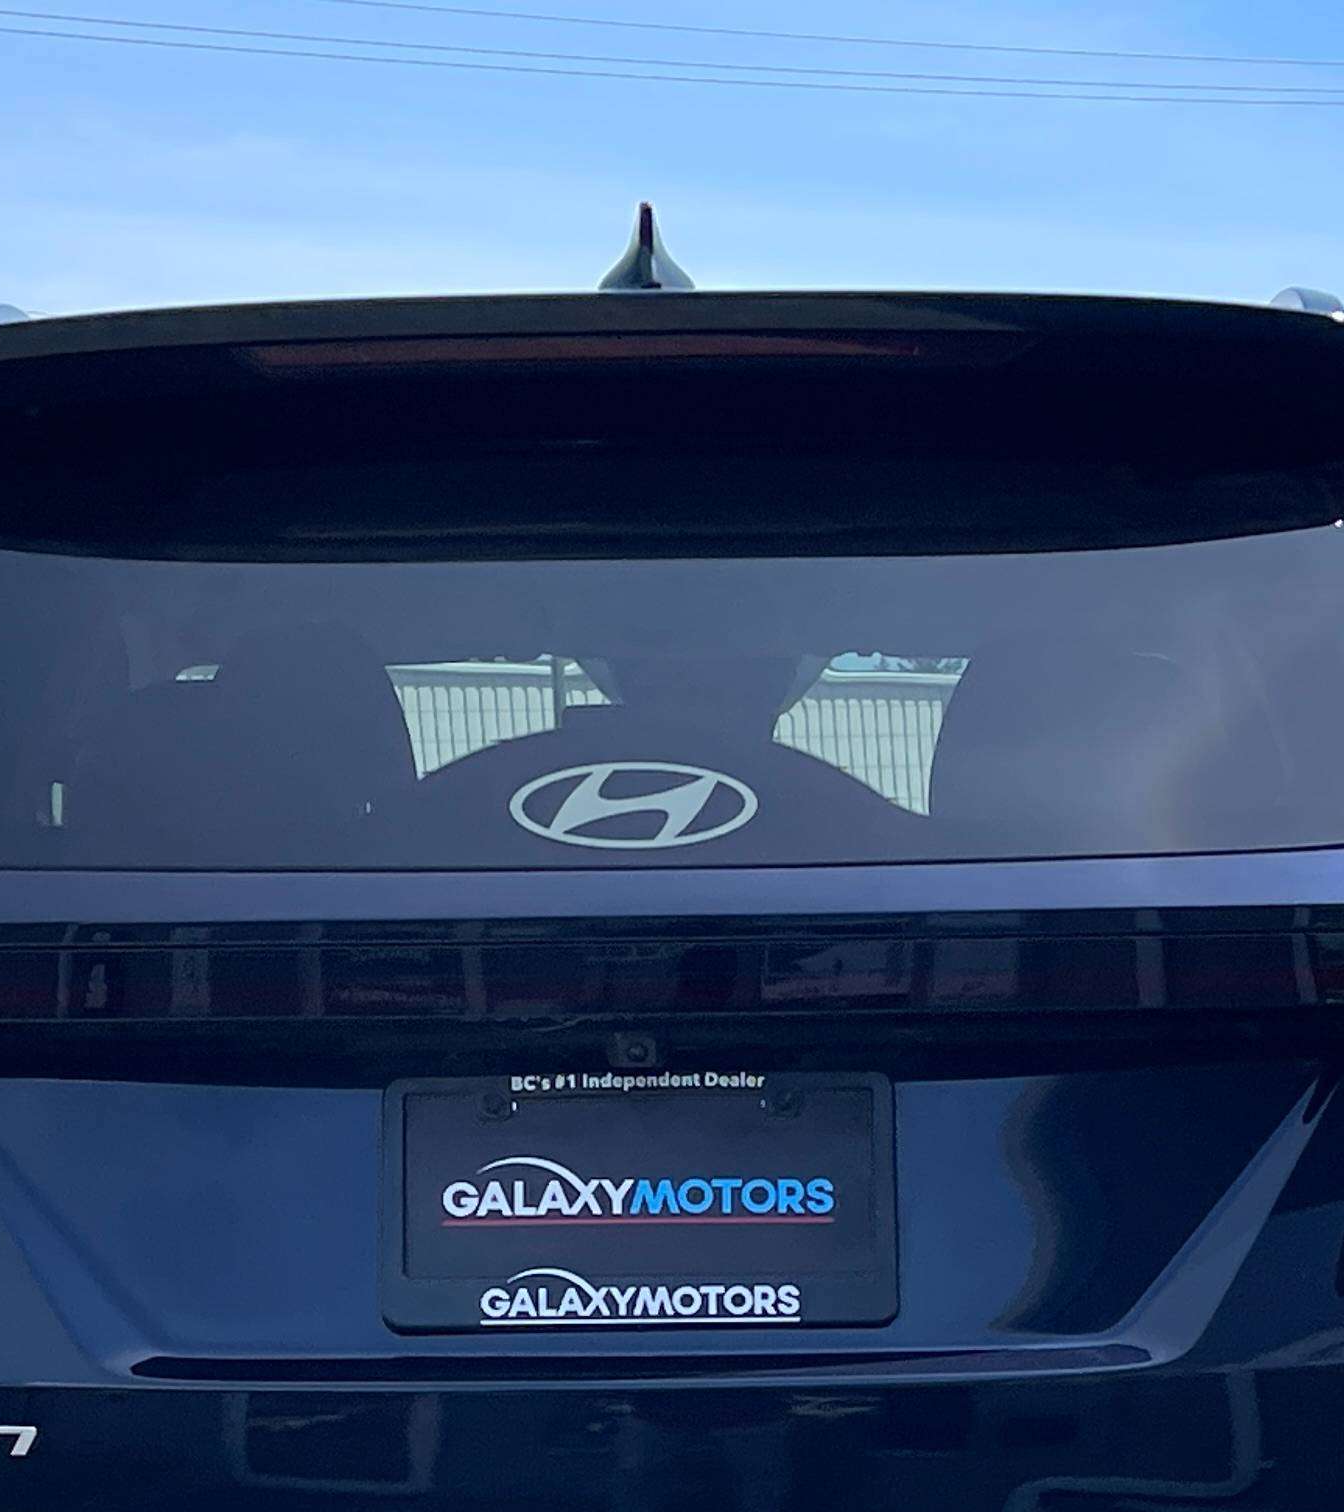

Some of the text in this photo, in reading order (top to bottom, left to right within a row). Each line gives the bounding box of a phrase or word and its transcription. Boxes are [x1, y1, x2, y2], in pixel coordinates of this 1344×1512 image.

[510, 1071, 765, 1091] BC's #1 Independent Dealer
